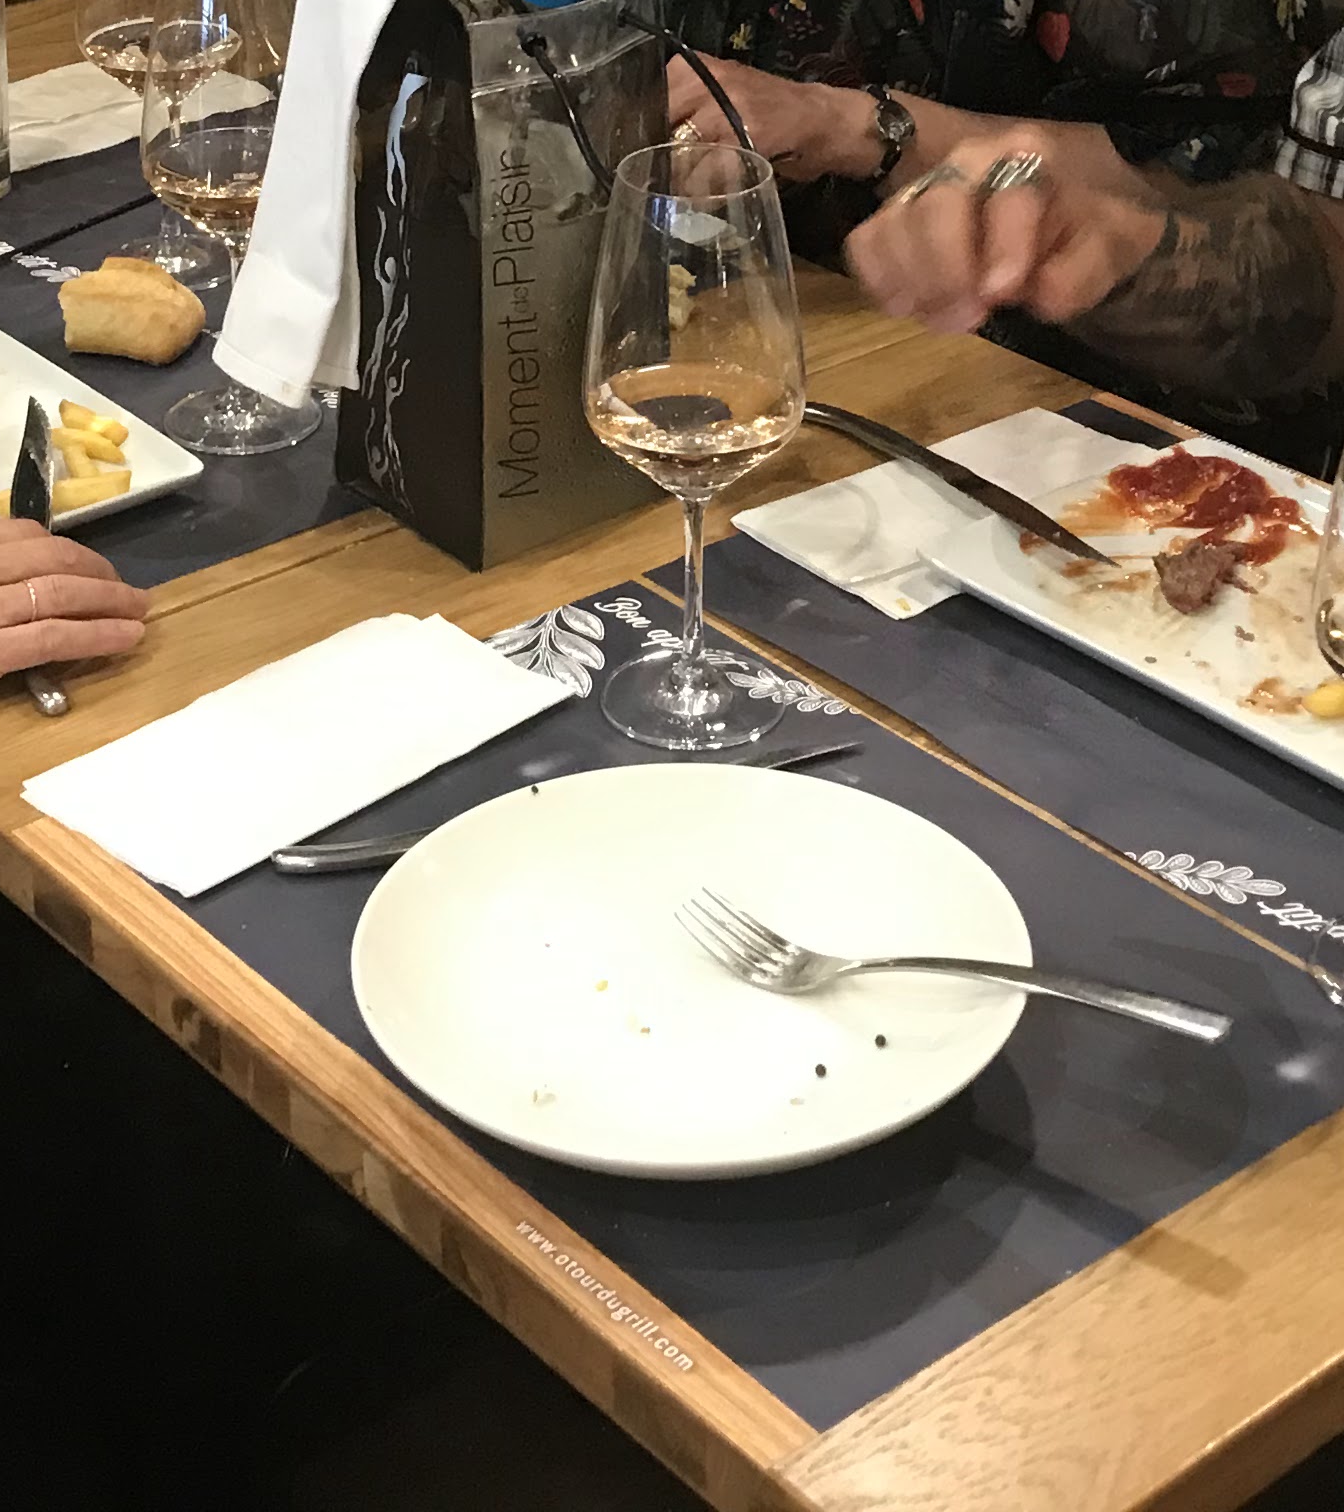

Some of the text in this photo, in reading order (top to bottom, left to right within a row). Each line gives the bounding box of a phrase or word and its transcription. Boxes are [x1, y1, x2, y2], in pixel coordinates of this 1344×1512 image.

[492, 150, 536, 287] Plaisir
[499, 313, 539, 499] Moment
[593, 596, 653, 630] Bon
[516, 1220, 694, 1372] www.otourdugrill.com
